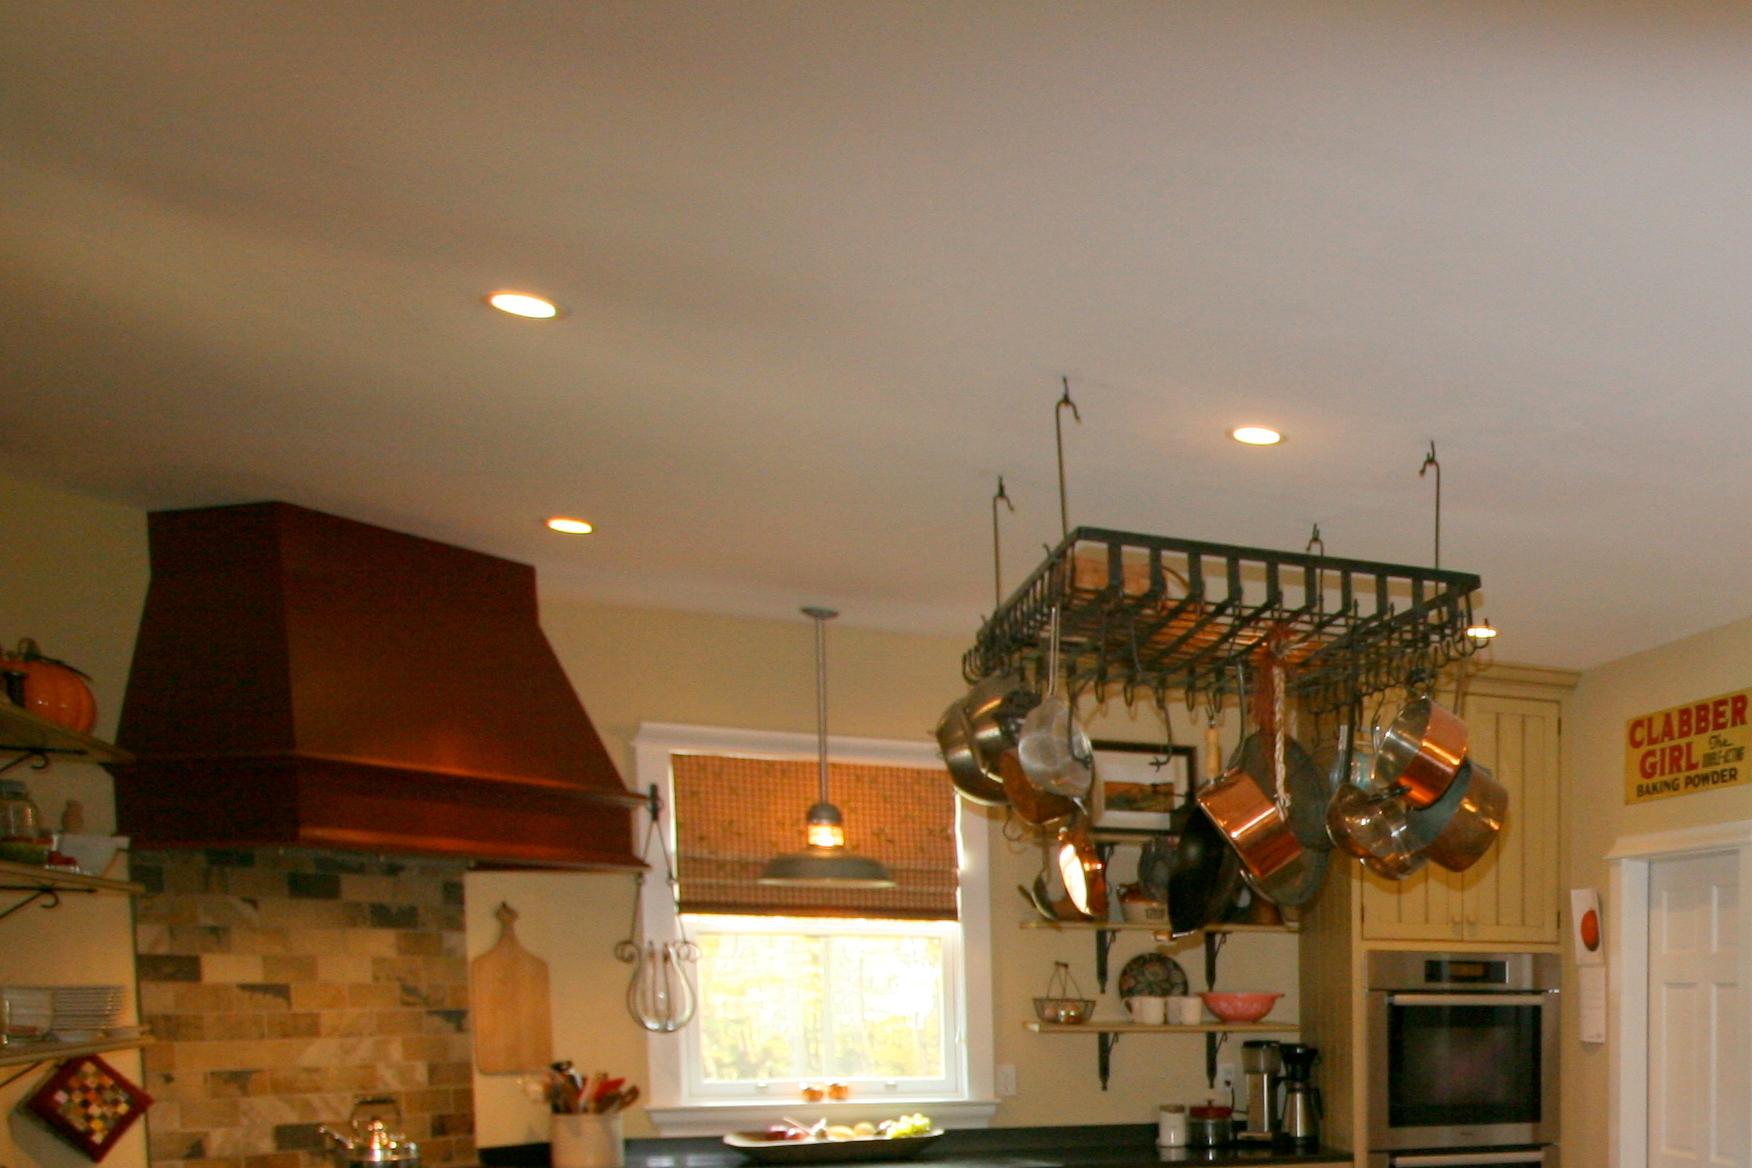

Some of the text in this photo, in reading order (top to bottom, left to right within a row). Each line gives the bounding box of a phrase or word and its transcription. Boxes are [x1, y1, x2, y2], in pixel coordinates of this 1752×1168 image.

[1629, 693, 1748, 749] CLABBER
[1639, 741, 1701, 780] GIRL
[1636, 767, 1739, 799] BAKING POWDER
